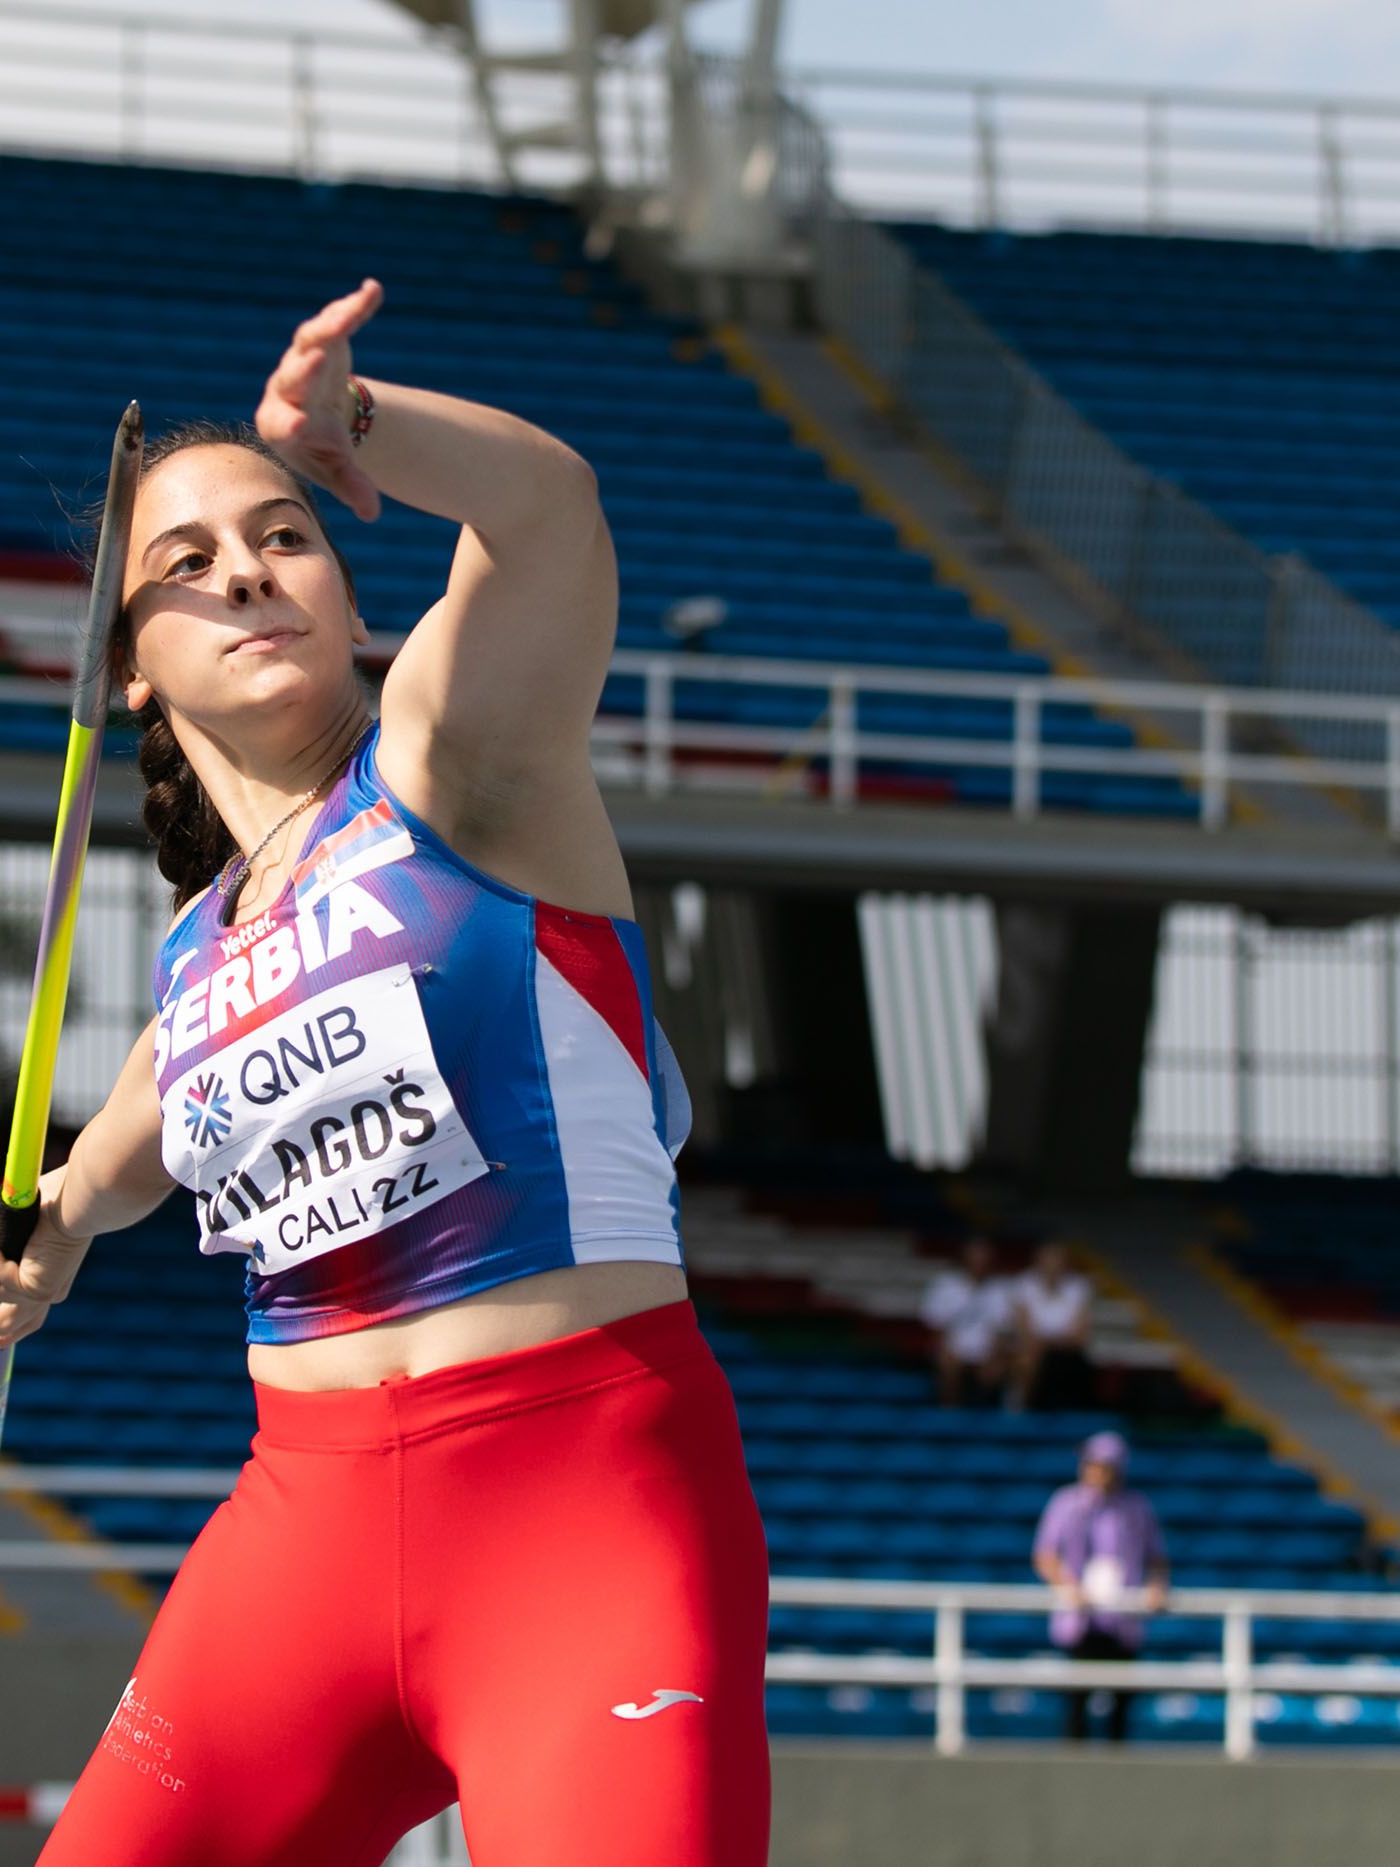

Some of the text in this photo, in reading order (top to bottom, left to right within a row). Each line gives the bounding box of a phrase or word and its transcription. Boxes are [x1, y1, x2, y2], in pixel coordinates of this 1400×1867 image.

[154, 880, 406, 1082] SERBIA
[240, 1006, 367, 1105] QNB
[197, 1068, 437, 1234] VILAGOŠ
[278, 1161, 440, 1252] CALI 22
